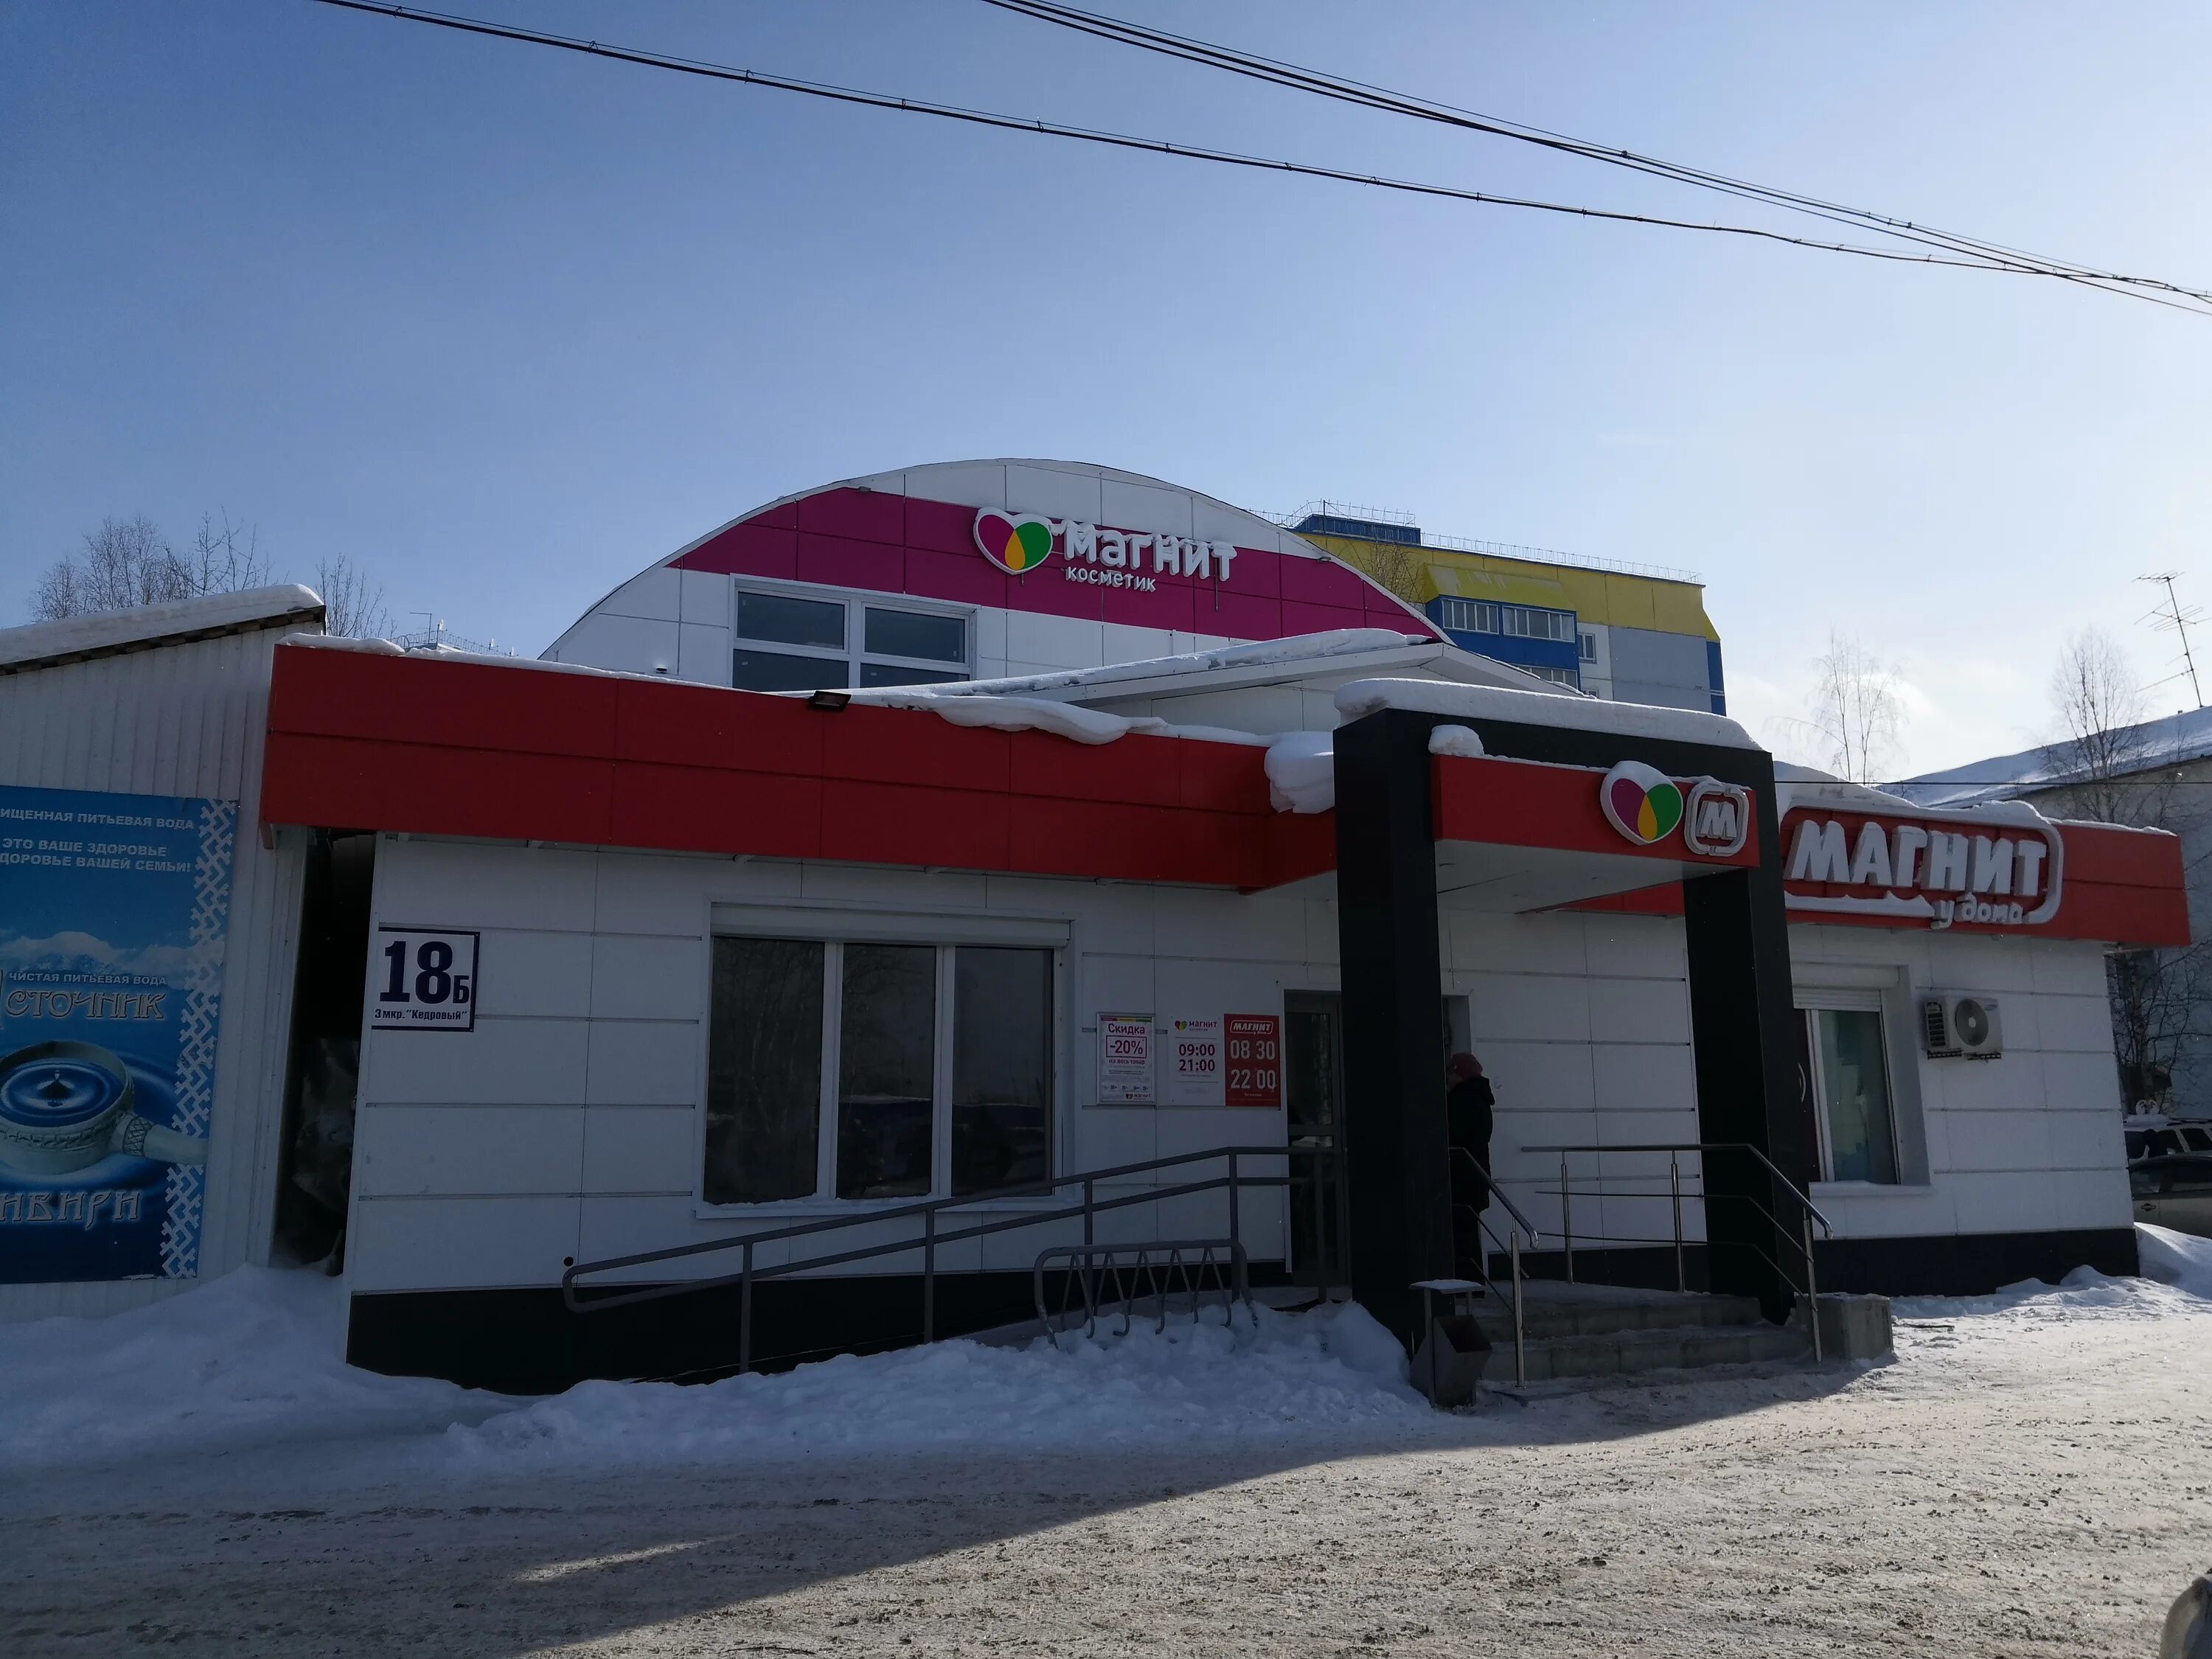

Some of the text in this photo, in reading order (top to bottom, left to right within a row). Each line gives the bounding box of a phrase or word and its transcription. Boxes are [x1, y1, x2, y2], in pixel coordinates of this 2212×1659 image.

[1063, 522, 1237, 581] магнит
[1066, 566, 1156, 593] косметик
[77, 813, 152, 827] ПИТЬЕВАЯ
[156, 818, 195, 830] ВОДА
[1696, 801, 1737, 841] М
[1, 837, 167, 858] ЭТО ВАШЕ ЗДОРОВЬЕ
[75, 856, 131, 870] ВАШЕЙ
[134, 860, 191, 873] СЕМЬИ!
[1785, 819, 2047, 897] МАГНИТ
[1931, 891, 2023, 930] у дома
[9, 973, 167, 987] ЧИСТАЯ ПИТЬЕВАЯ ВОДА
[0, 990, 167, 1020] СТОЧНИК
[1108, 1023, 1146, 1034] Скидка
[1189, 1020, 1217, 1029] магнит
[1233, 1022, 1272, 1032] МАГНИТ
[1110, 1040, 1144, 1054] -20%
[1178, 1043, 1216, 1057] 09:00
[1179, 1059, 1216, 1071] 21:00
